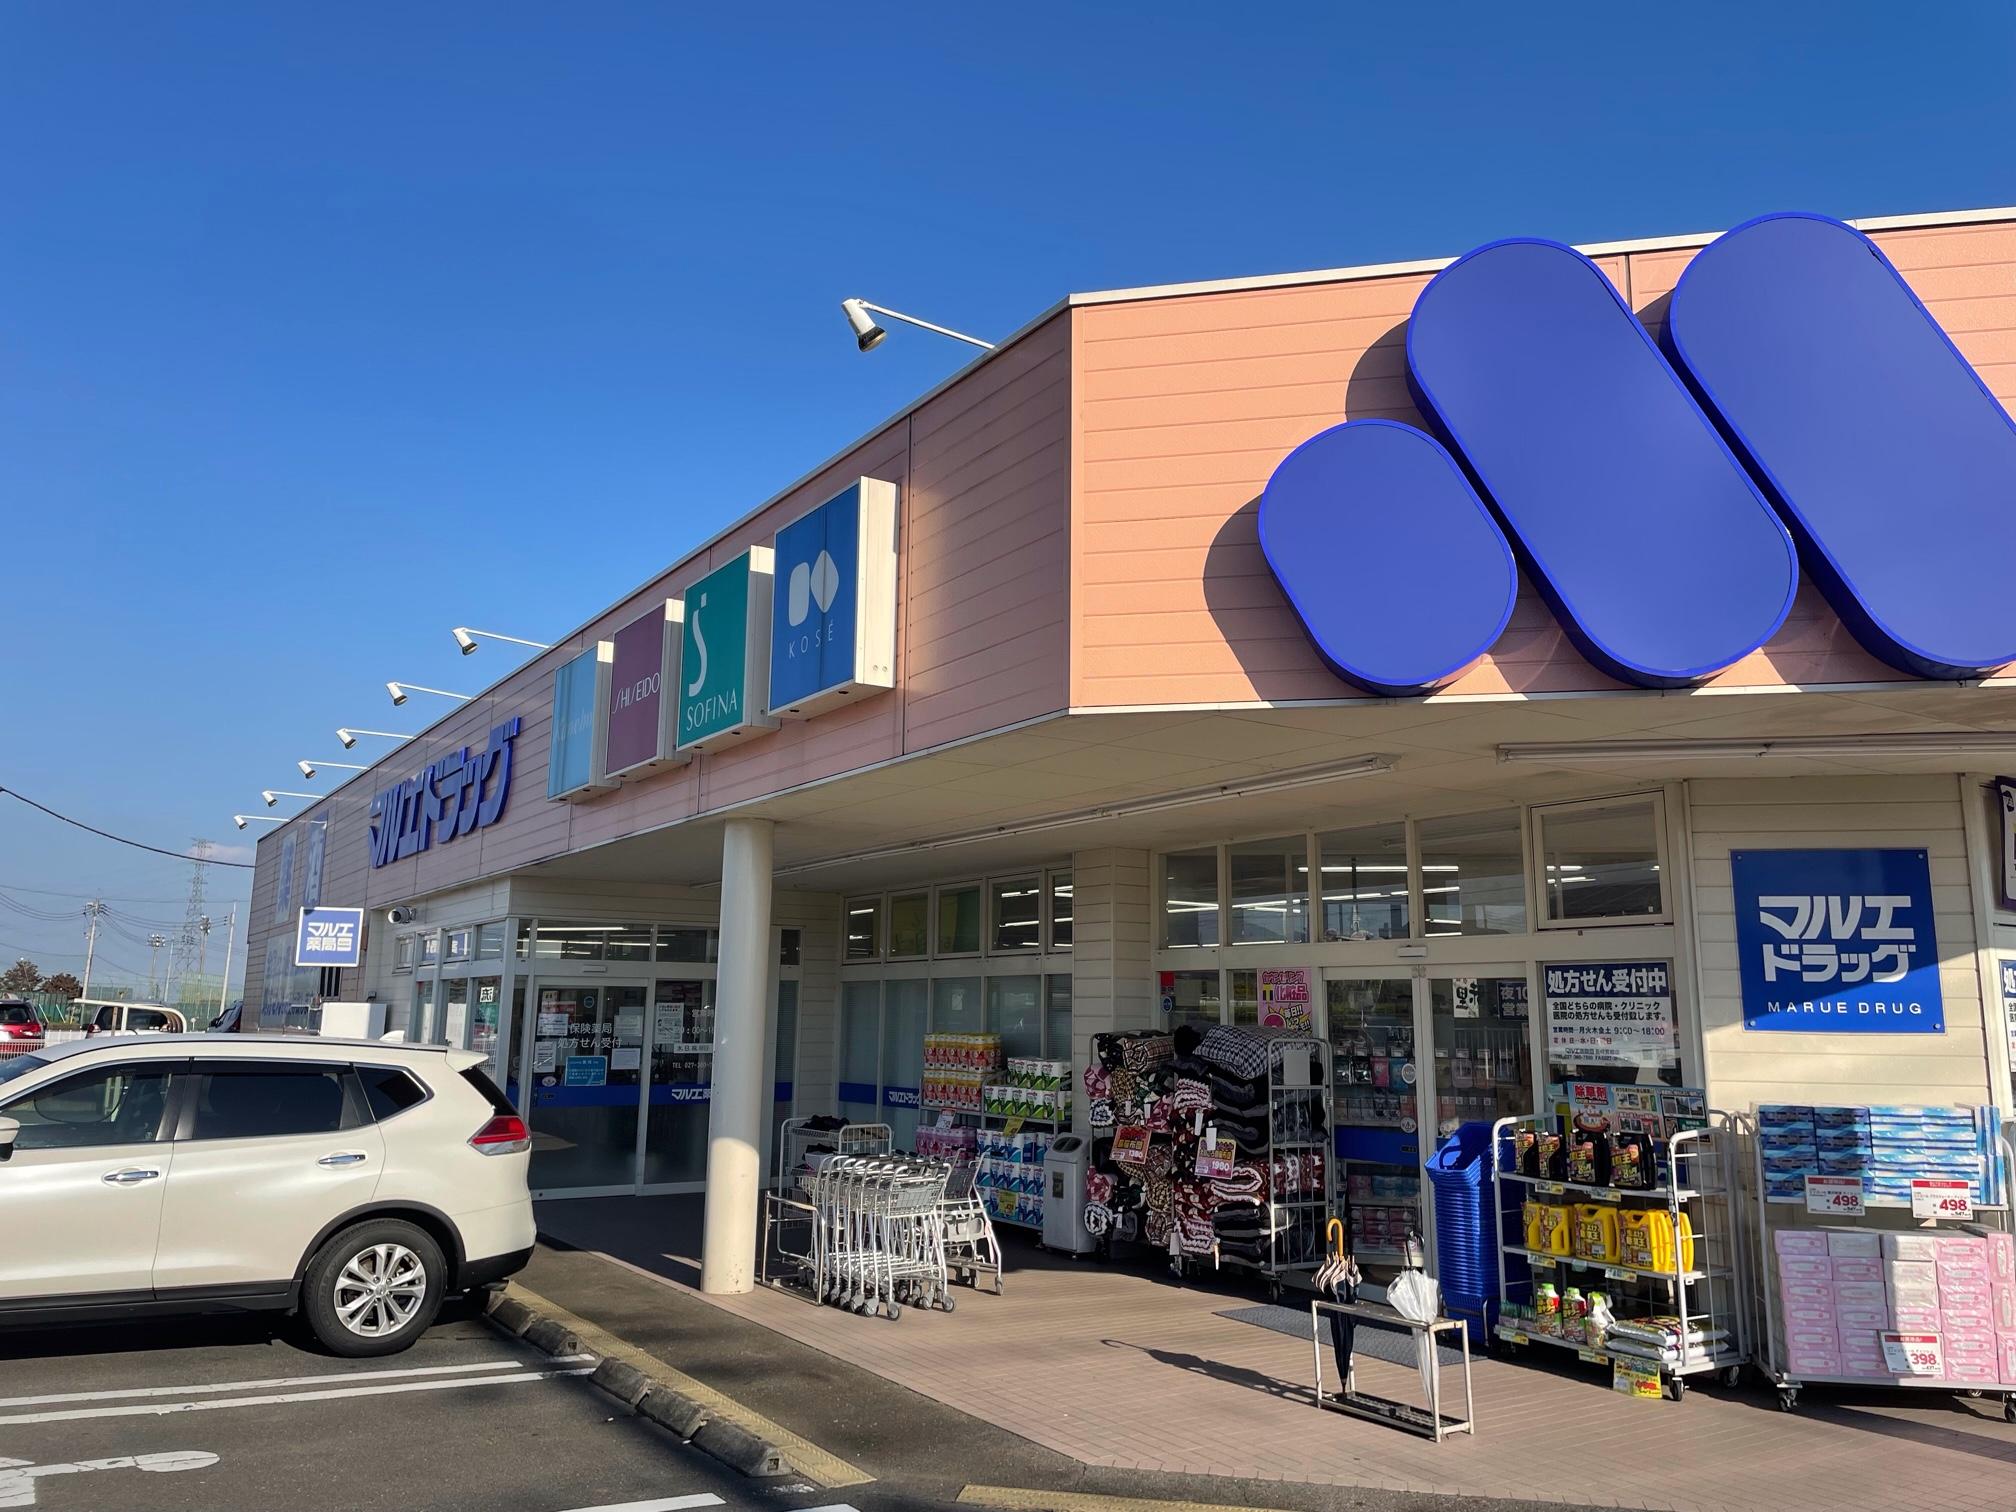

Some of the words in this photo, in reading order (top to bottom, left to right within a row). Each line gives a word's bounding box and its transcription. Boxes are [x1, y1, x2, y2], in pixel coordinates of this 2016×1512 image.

[789, 618, 833, 659] KOSÉ
[612, 672, 660, 714] SHISEIDO
[686, 688, 738, 732] SOFINA
[368, 715, 522, 869] マルエドラッグ
[1758, 895, 1915, 940] マルエ
[307, 922, 354, 938] マルエ
[1762, 943, 1917, 983] ドラッグ
[1547, 967, 1667, 994] 処方せん受付中
[1767, 1001, 1849, 1014] MARUE
[1858, 1002, 1923, 1016] DRUG
[569, 1022, 613, 1035] 保険薬局
[557, 1037, 623, 1049] 処方せん受付
[1574, 1084, 1608, 1100] 除草剤
[1832, 1194, 1859, 1207] 498
[1939, 1199, 1968, 1211] 498
[1910, 1353, 1937, 1365] 398
